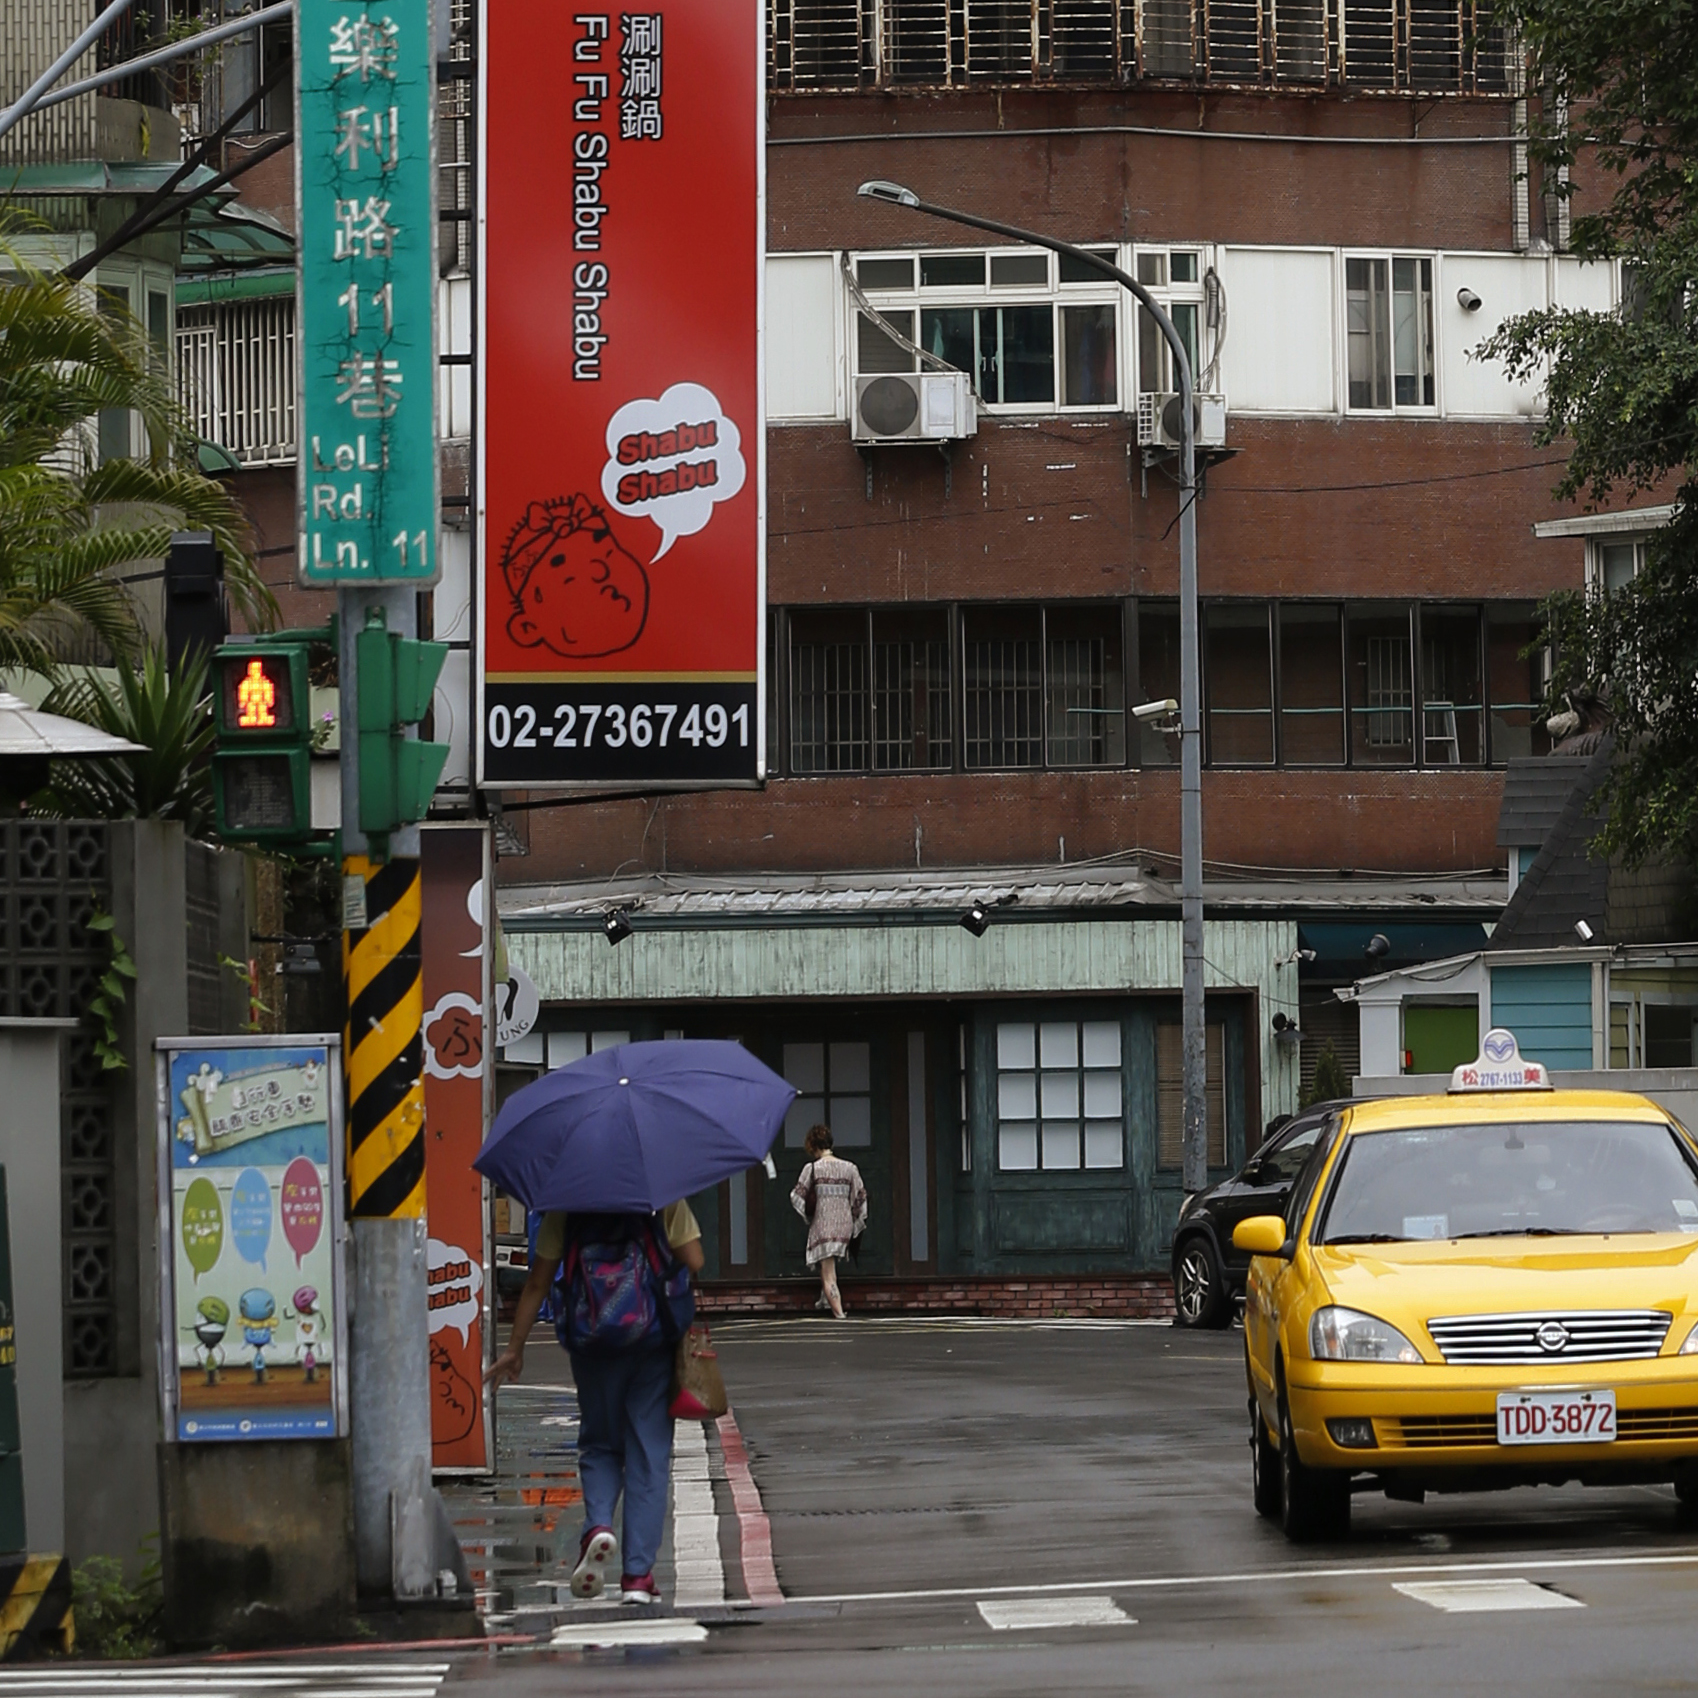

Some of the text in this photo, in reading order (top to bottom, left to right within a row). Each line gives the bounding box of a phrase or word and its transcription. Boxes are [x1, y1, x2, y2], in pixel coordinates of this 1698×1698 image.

[619, 13, 664, 141] 涮涮鍋
[573, 14, 610, 382] Fu Fu Shabu Shabu
[311, 434, 390, 472] LeLi
[311, 482, 375, 522] Rd.
[311, 529, 429, 569] Ln. 11
[488, 703, 749, 748] 02-27367491
[499, 1019, 529, 1041] UNG
[1461, 1068, 1479, 1086] 松
[1523, 1067, 1541, 1085] 美
[427, 1260, 471, 1286] abu
[428, 1285, 471, 1311] abu
